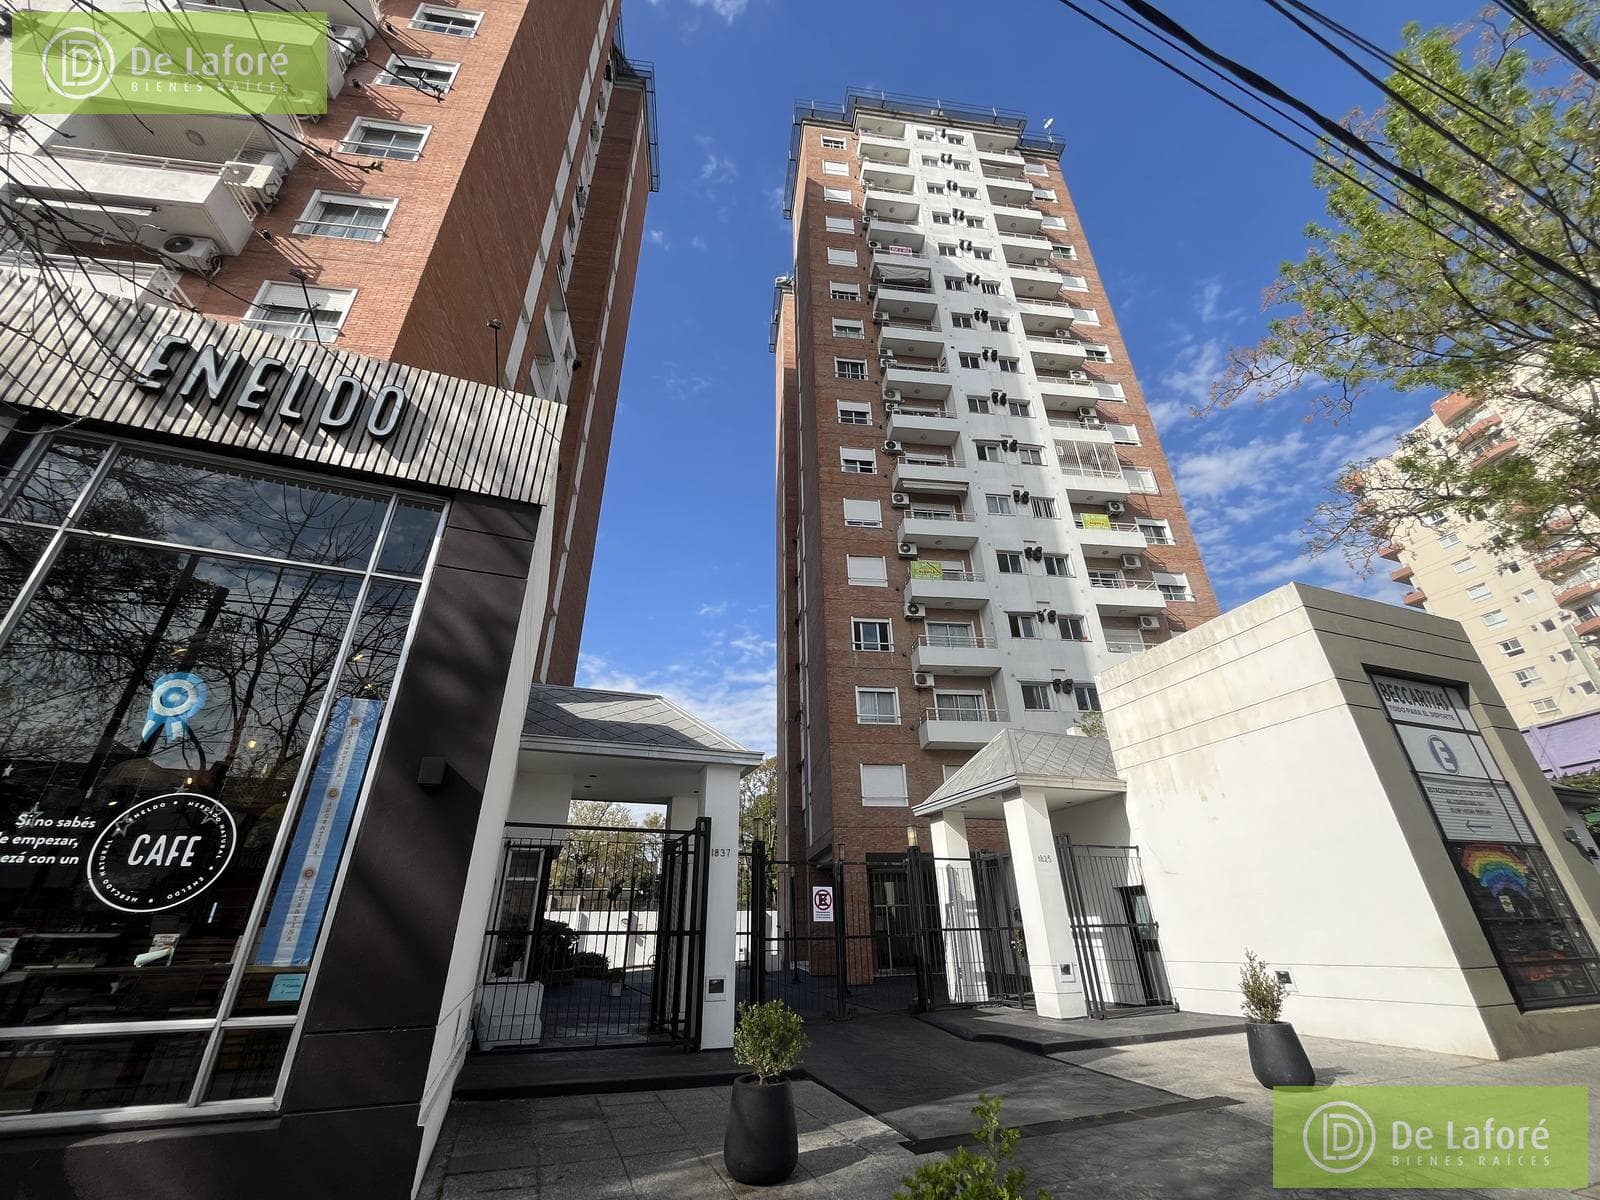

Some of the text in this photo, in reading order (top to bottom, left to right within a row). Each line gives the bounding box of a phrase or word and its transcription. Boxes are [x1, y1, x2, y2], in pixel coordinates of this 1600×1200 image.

[135, 334, 406, 441] ENELDO
[1377, 682, 1449, 711] BECCARITAS
[34, 818, 53, 826] no
[56, 816, 96, 828] sabés
[12, 836, 79, 849] empezar,
[127, 834, 202, 867] CAFE
[711, 848, 731, 857] 1837
[28, 855, 56, 864] con
[59, 856, 79, 864] un
